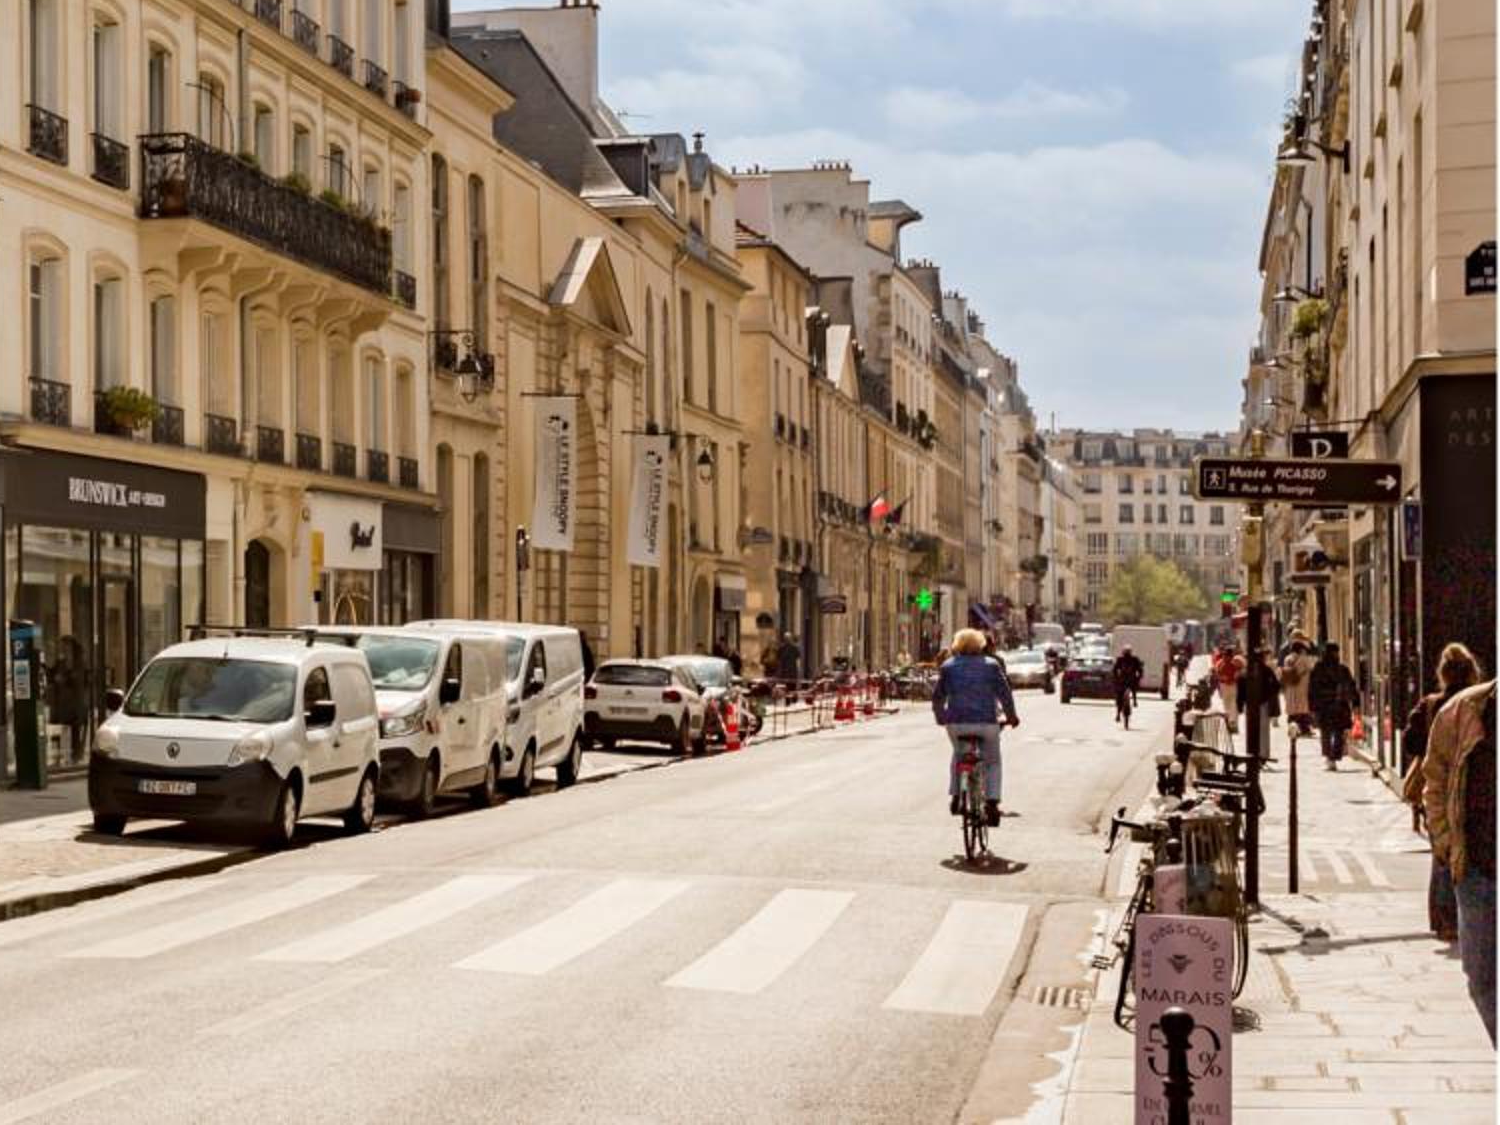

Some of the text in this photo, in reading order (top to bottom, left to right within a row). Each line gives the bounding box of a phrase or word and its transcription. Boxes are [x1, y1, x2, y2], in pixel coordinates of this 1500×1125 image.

[1229, 466, 1327, 481] Musée PICASSO
[1241, 483, 1259, 493] Rue
[1141, 987, 1225, 1006] MARAIS
